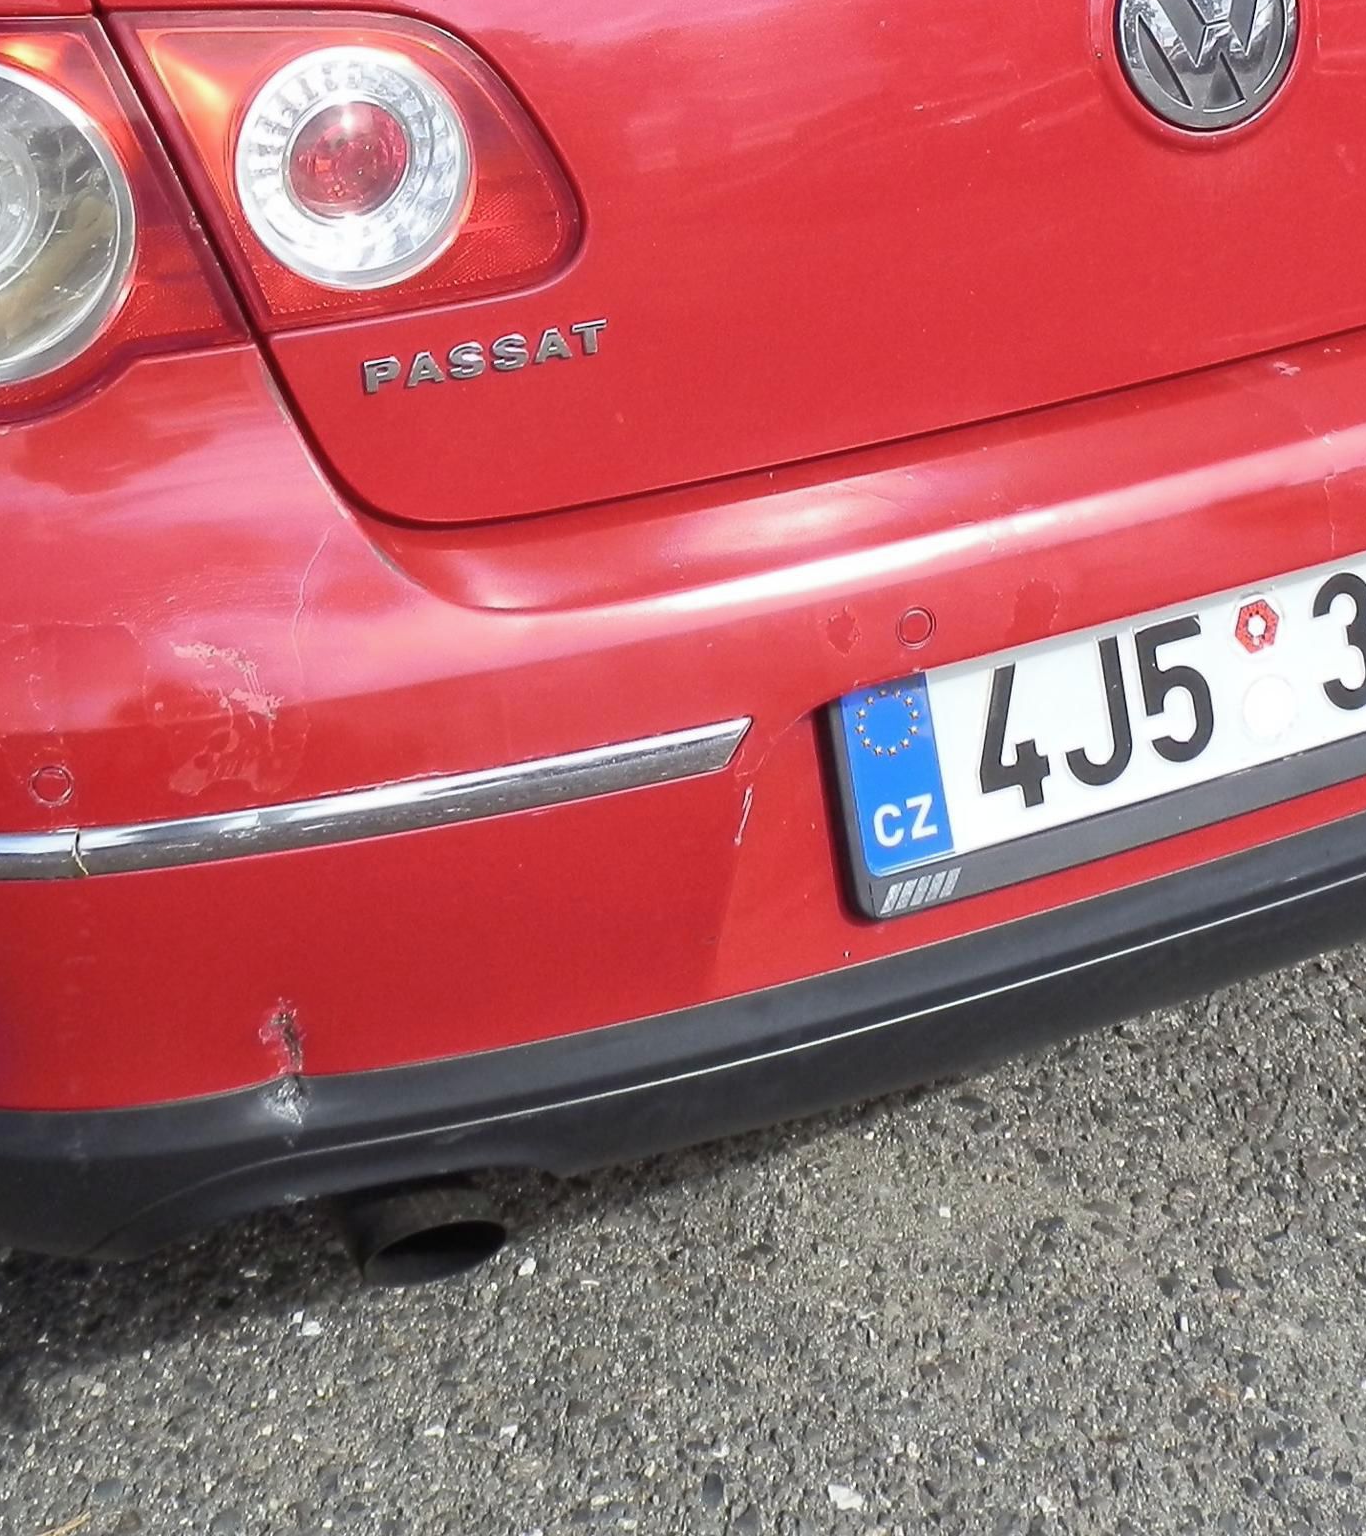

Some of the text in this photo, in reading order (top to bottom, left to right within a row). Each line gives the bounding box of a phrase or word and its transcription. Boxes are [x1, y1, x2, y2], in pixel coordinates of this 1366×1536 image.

[362, 319, 608, 394] PASSAT
[978, 614, 1216, 808] 4J5
[873, 793, 939, 849] CZ
